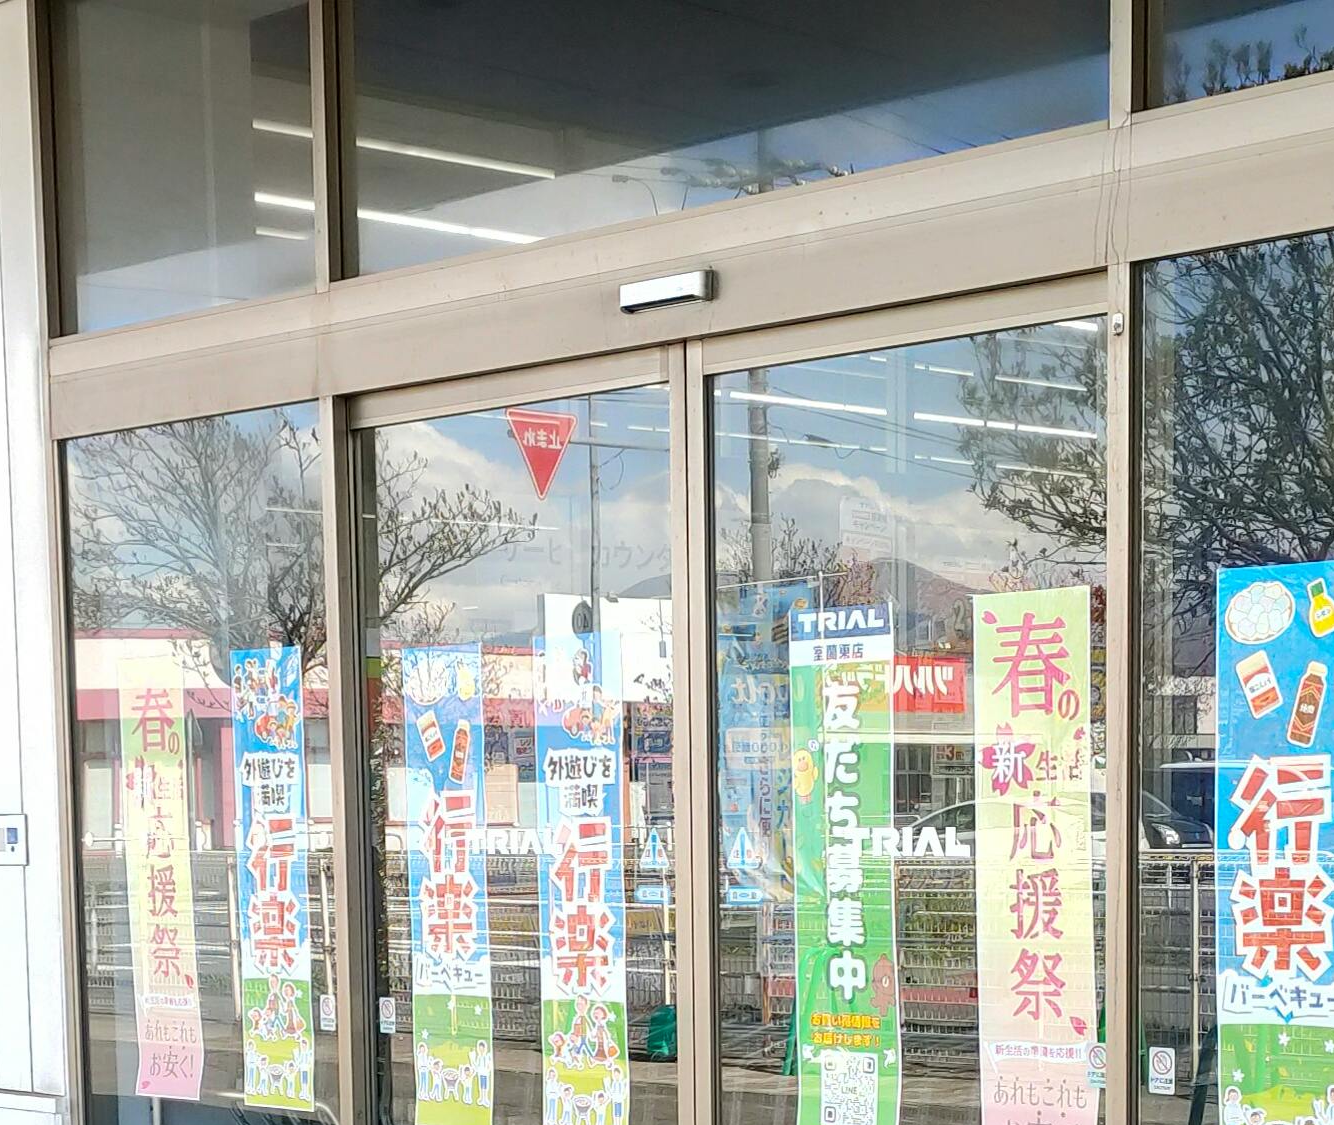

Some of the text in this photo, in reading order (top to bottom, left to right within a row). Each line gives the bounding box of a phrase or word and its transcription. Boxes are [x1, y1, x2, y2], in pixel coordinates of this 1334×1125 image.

[797, 608, 885, 633] TRIAL
[131, 689, 180, 755] 春の
[243, 757, 297, 781] 外遊びを
[547, 748, 613, 782] 外遊びを
[467, 826, 565, 855] TRIAL
[823, 680, 867, 1001] 友だち募集中
[852, 826, 971, 858] TRIAL
[425, 794, 474, 953] 行楽
[1237, 760, 1329, 972] 行楽
[250, 814, 297, 968] 行楽
[554, 821, 610, 987] 行楽
[418, 963, 486, 984] バーベキュー
[149, 1048, 195, 1079] お安く!
[841, 1085, 858, 1095] LINE
[993, 1078, 1088, 1109] あれもこれも
